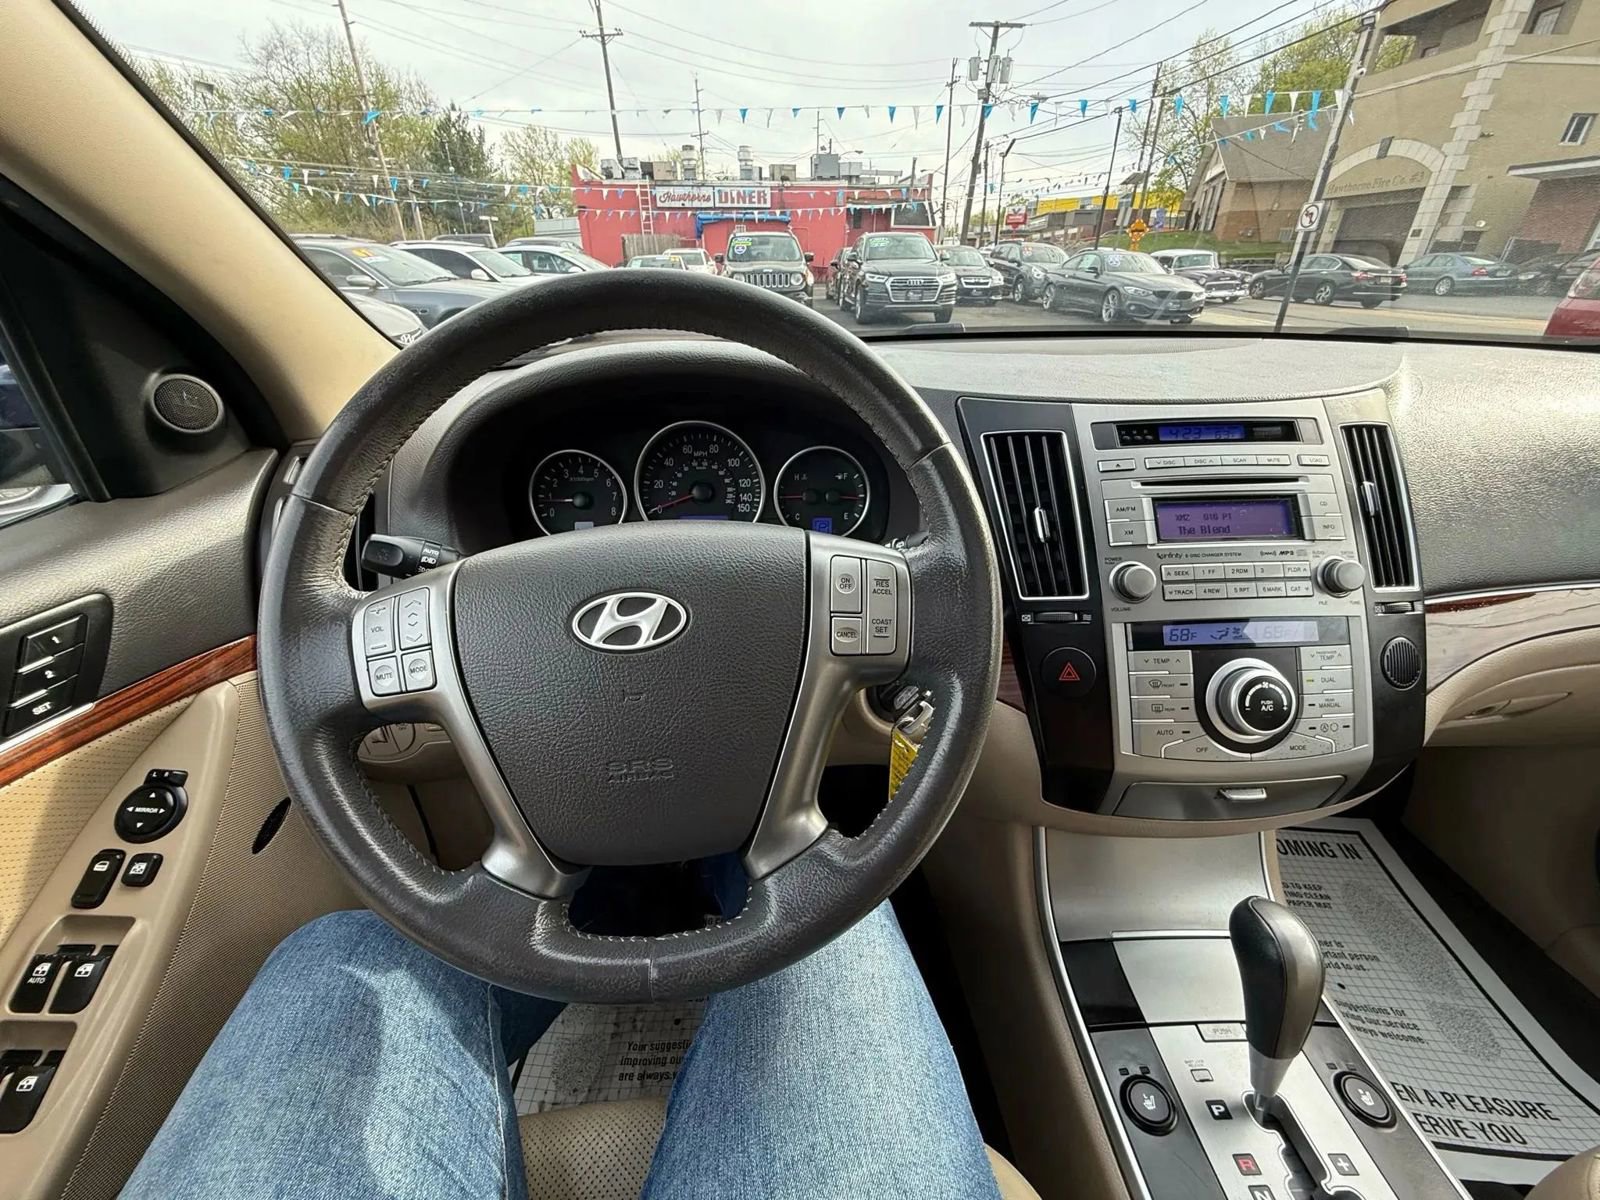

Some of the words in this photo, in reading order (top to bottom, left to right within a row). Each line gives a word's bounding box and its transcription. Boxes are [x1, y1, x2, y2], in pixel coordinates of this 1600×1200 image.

[1372, 177, 1391, 188] Fire
[659, 190, 711, 204] Hawthorne
[717, 188, 768, 205] DINER
[682, 445, 693, 454] 60
[709, 444, 719, 453] 80
[664, 458, 674, 467] 40
[727, 458, 740, 467] 100
[654, 480, 664, 489] 20
[738, 478, 751, 487] 120
[739, 493, 752, 502] 140
[737, 503, 750, 512] 150
[795, 513, 800, 521] C
[843, 512, 849, 520] E
[1177, 525, 1195, 536] The
[1200, 524, 1231, 535] Blend
[423, 548, 440, 556] AUTO
[872, 588, 892, 596] ACCEL
[52, 636, 61, 644] 1
[1153, 657, 1170, 665] TEMP
[44, 670, 55, 679] 2
[409, 665, 428, 675] MODE
[375, 672, 393, 681] MUTE
[32, 701, 53, 715] SET
[1156, 728, 1174, 736] AUTO
[606, 759, 674, 772] SRS
[1276, 838, 1338, 859] OMING
[1336, 842, 1363, 861] IN
[1303, 883, 1323, 891] KEEP
[1303, 891, 1332, 900] CLEAN
[1286, 899, 1313, 908] PAPER
[1314, 900, 1333, 909] MAT
[1348, 952, 1381, 962] person
[1341, 962, 1353, 970] to
[1390, 1007, 1406, 1017] for
[1381, 1019, 1420, 1031] service
[627, 1041, 649, 1051] Your
[620, 1055, 667, 1068] improving
[670, 1055, 684, 1065] ou
[618, 1072, 635, 1081] are
[637, 1070, 670, 1083] always
[1390, 1081, 1423, 1105] EN
[1422, 1089, 1444, 1109] A
[1440, 1091, 1561, 1121] PLEASURE
[1210, 1105, 1226, 1116] P
[1411, 1112, 1477, 1140] ERVE
[1472, 1120, 1528, 1145] YOU
[1238, 1158, 1255, 1171] R
[1255, 1190, 1272, 1200] N
